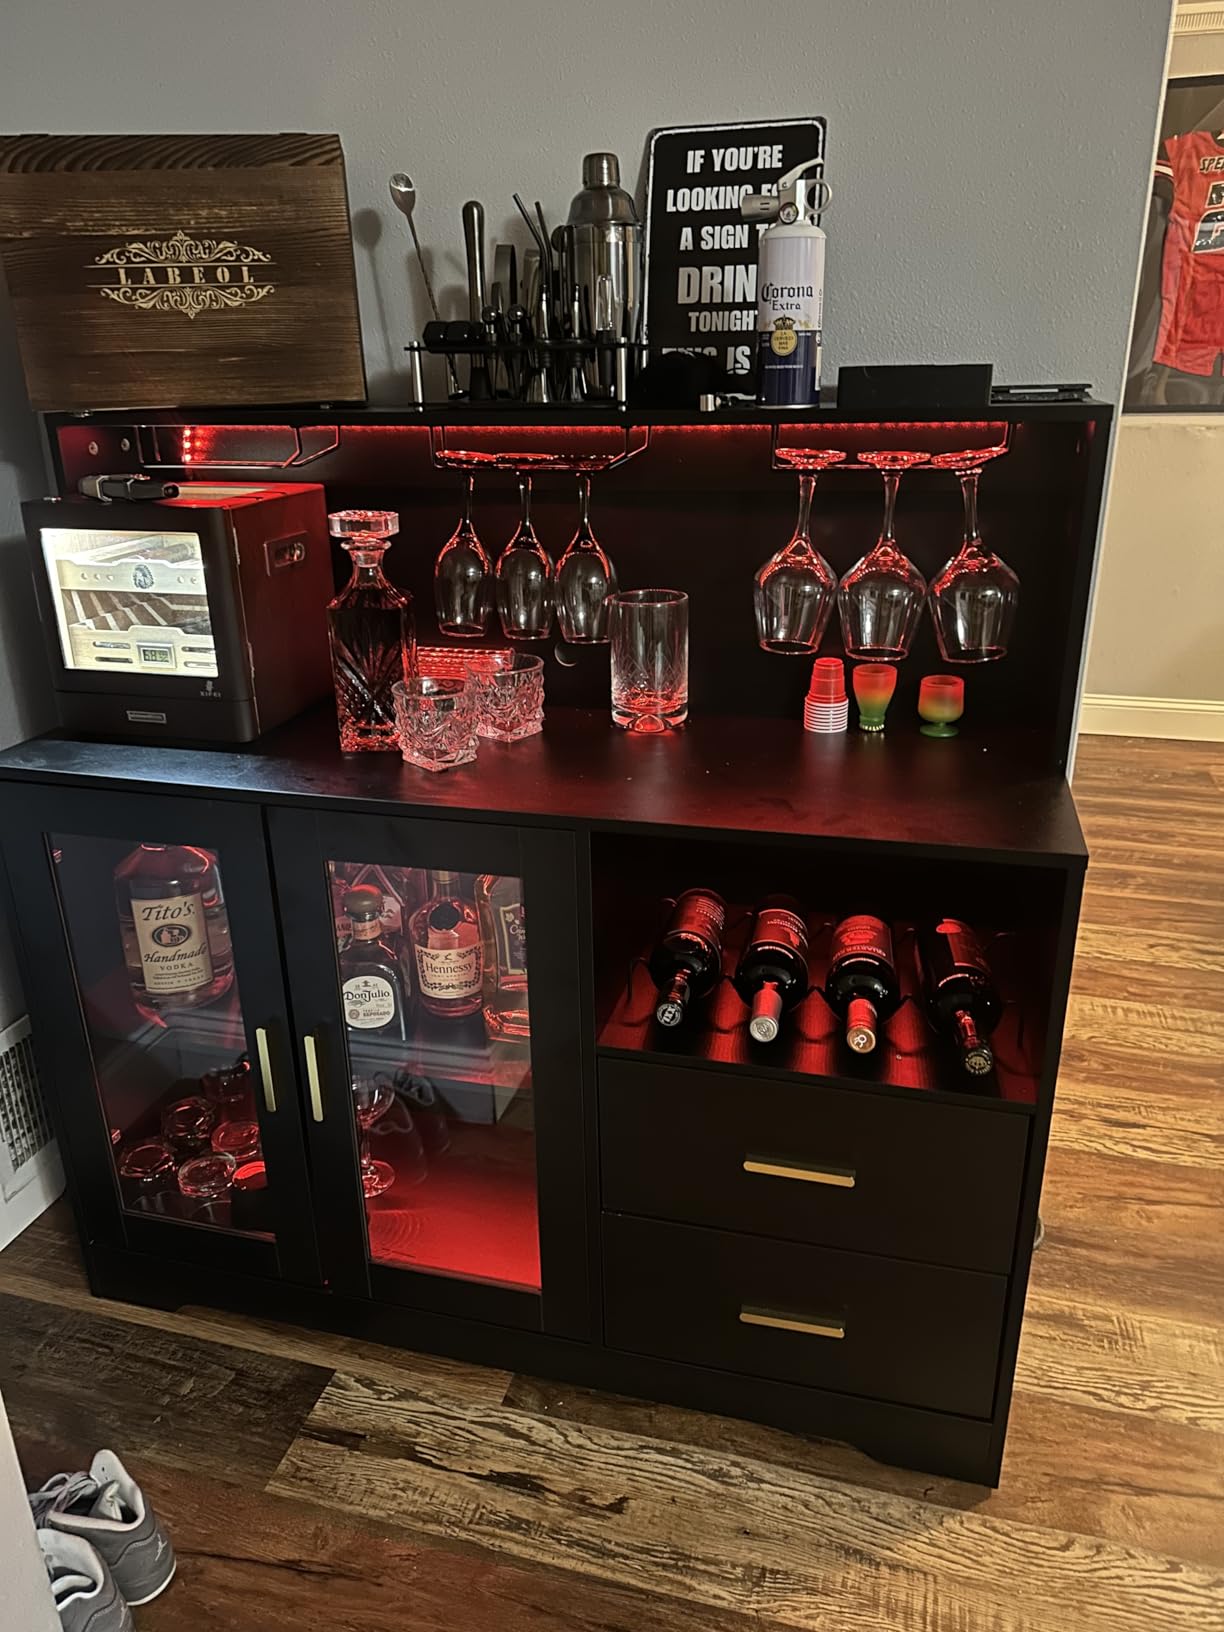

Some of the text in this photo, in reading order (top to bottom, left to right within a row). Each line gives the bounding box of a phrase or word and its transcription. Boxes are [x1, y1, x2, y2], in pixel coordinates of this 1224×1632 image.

[686, 144, 784, 174] IF YOU'RE
[679, 226, 694, 251] A
[700, 224, 749, 250] SIGN
[677, 263, 758, 305] DRIN
[761, 282, 814, 303] Corona
[771, 299, 801, 311] Extra
[688, 309, 759, 332] TONIGH
[726, 345, 751, 375] IS
[144, 942, 207, 963] Handmade
[160, 962, 193, 971] VODKA
[425, 961, 473, 974] Hennessy
